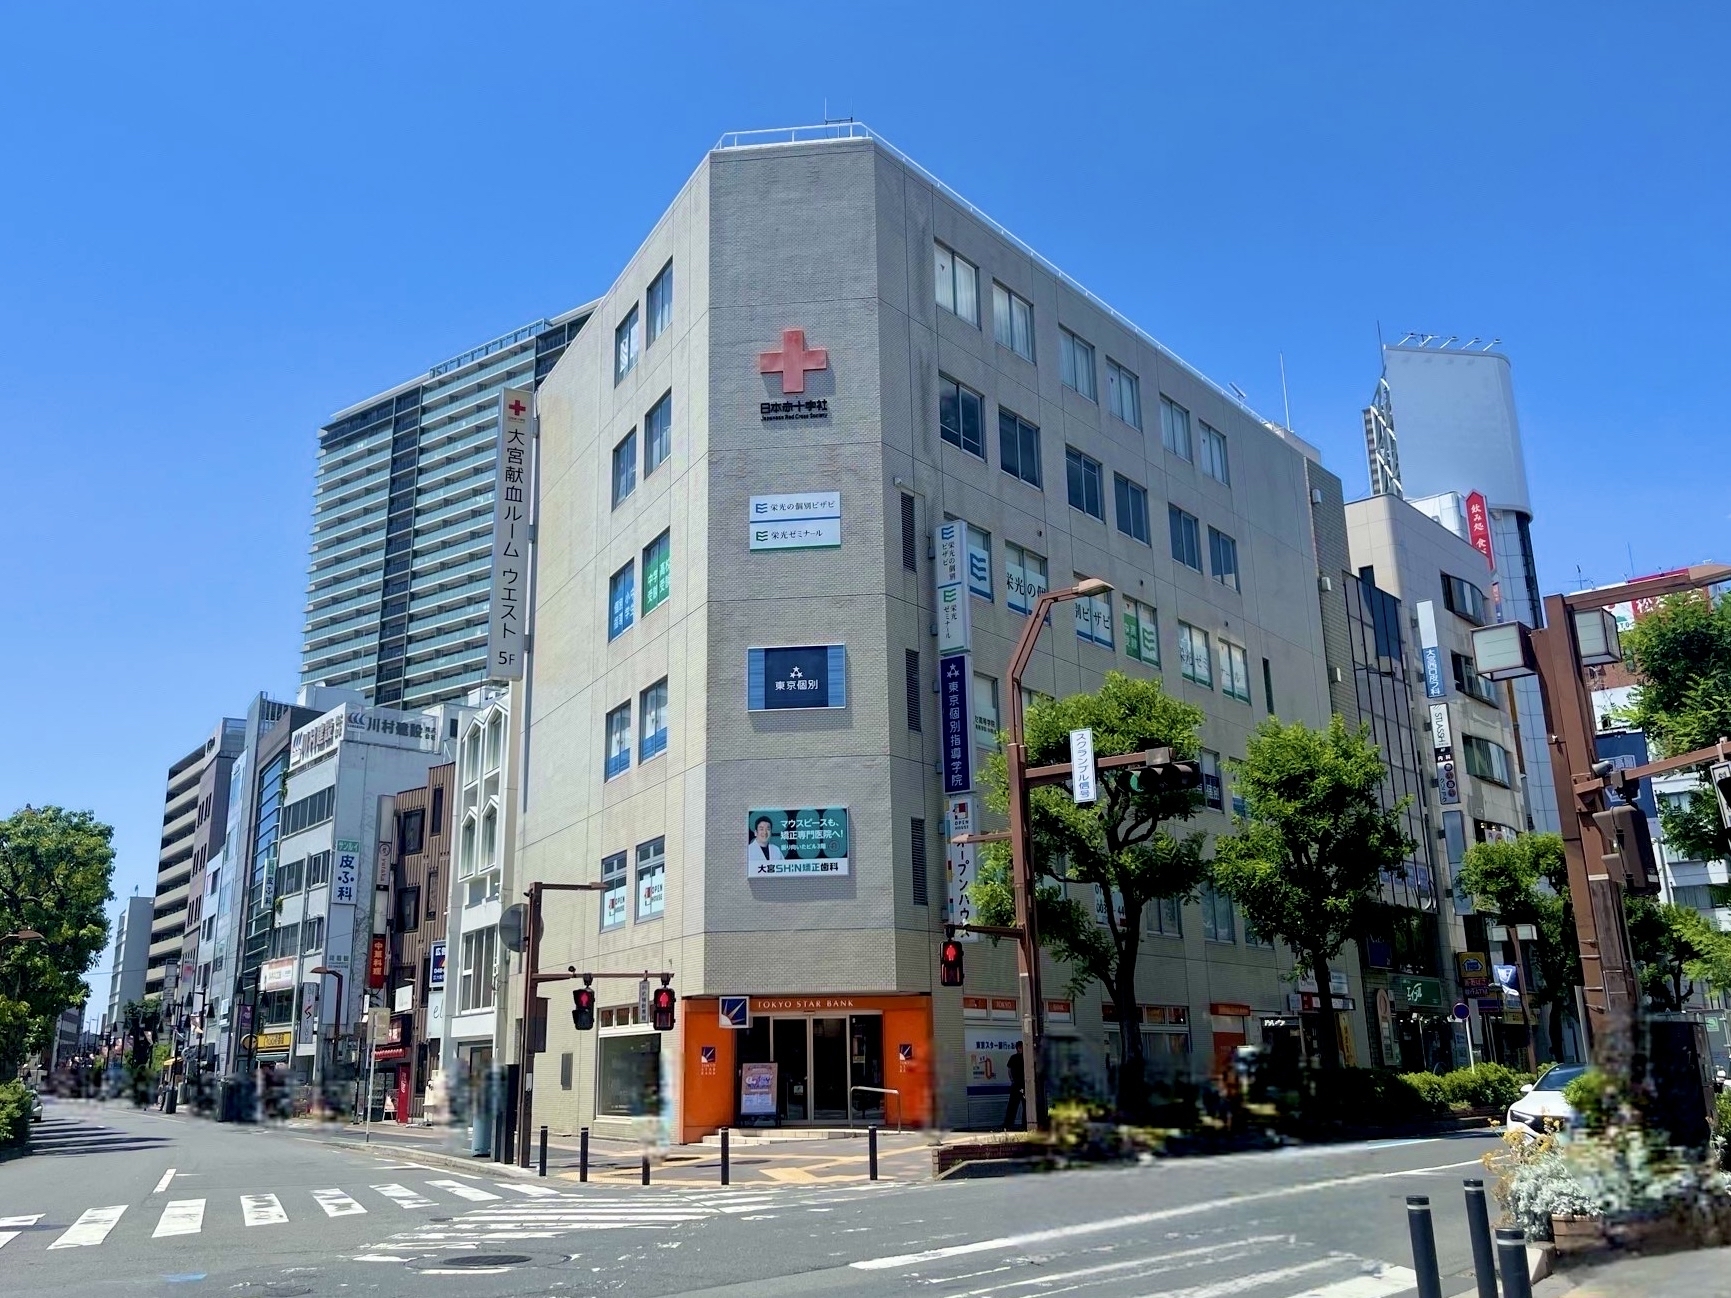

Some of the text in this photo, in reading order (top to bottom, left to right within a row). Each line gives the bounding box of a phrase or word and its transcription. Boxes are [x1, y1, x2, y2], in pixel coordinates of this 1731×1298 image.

[761, 399, 828, 413] 日本赤十字社
[503, 428, 525, 559] 大宮献血ルーム
[771, 501, 836, 511] 栄光の個別ビザビ
[771, 530, 823, 540] 栄光ゼミナール
[500, 568, 519, 639] ウエスト
[951, 604, 957, 620] 栄光
[498, 651, 516, 665] 5F
[775, 678, 819, 691] 東京個別
[367, 717, 423, 738] 川村建設
[949, 681, 963, 786] 東京個別指導学院
[1076, 733, 1090, 798] スクランブル信号
[780, 818, 840, 828] マウスピースも、
[780, 829, 844, 840] 矯正専門医院へ!
[758, 862, 838, 873] 大宮SHIN矯正歯科
[338, 855, 354, 901] 皮ふ科
[758, 999, 854, 1008] TOKYO STAR BANK
